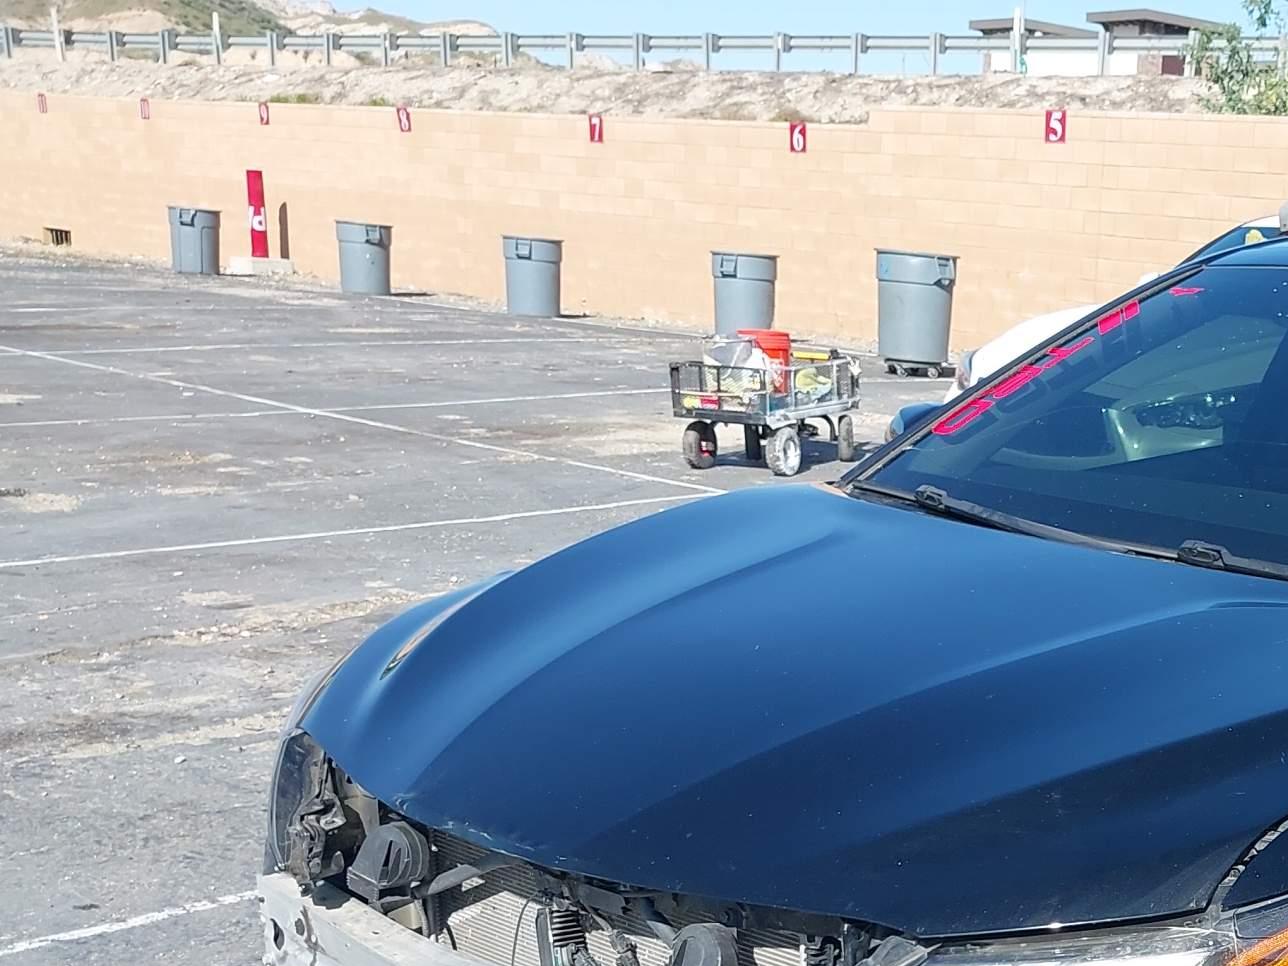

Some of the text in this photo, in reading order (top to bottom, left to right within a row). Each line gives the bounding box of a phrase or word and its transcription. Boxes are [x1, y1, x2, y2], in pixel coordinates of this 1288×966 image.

[591, 116, 601, 142] 7
[792, 124, 804, 152] 6
[1048, 111, 1063, 142] 5
